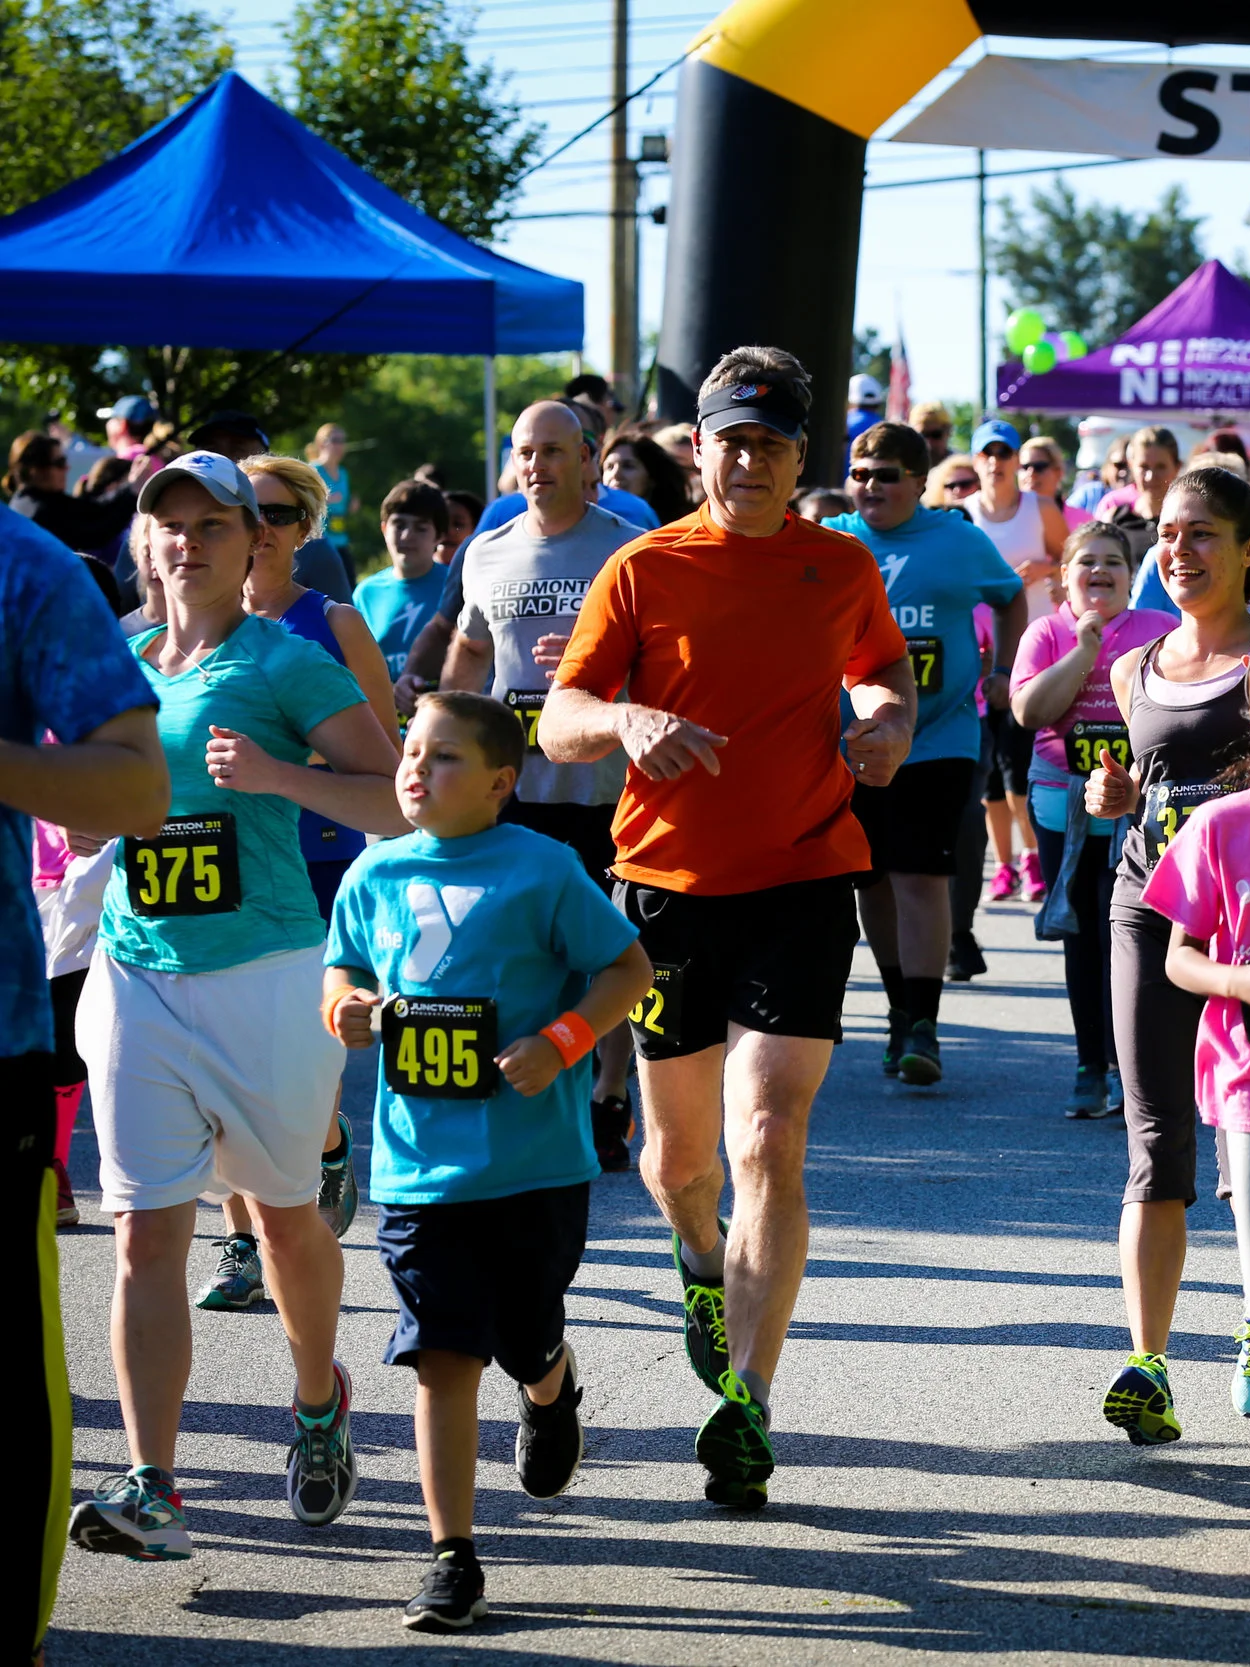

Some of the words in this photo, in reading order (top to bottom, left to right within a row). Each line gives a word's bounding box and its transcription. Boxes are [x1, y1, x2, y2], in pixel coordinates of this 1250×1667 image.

[492, 580, 588, 597] PIEDMONT
[493, 598, 553, 618] TRIAD
[1170, 784, 1221, 793] JUNCTION
[160, 821, 204, 832] NCTION
[204, 820, 222, 829] 311
[136, 845, 221, 905] 375
[376, 926, 403, 949] the
[431, 954, 454, 982] YMCA
[409, 1003, 464, 1014] JUNCTION
[465, 1004, 482, 1013] 311
[396, 1026, 479, 1088] 495
